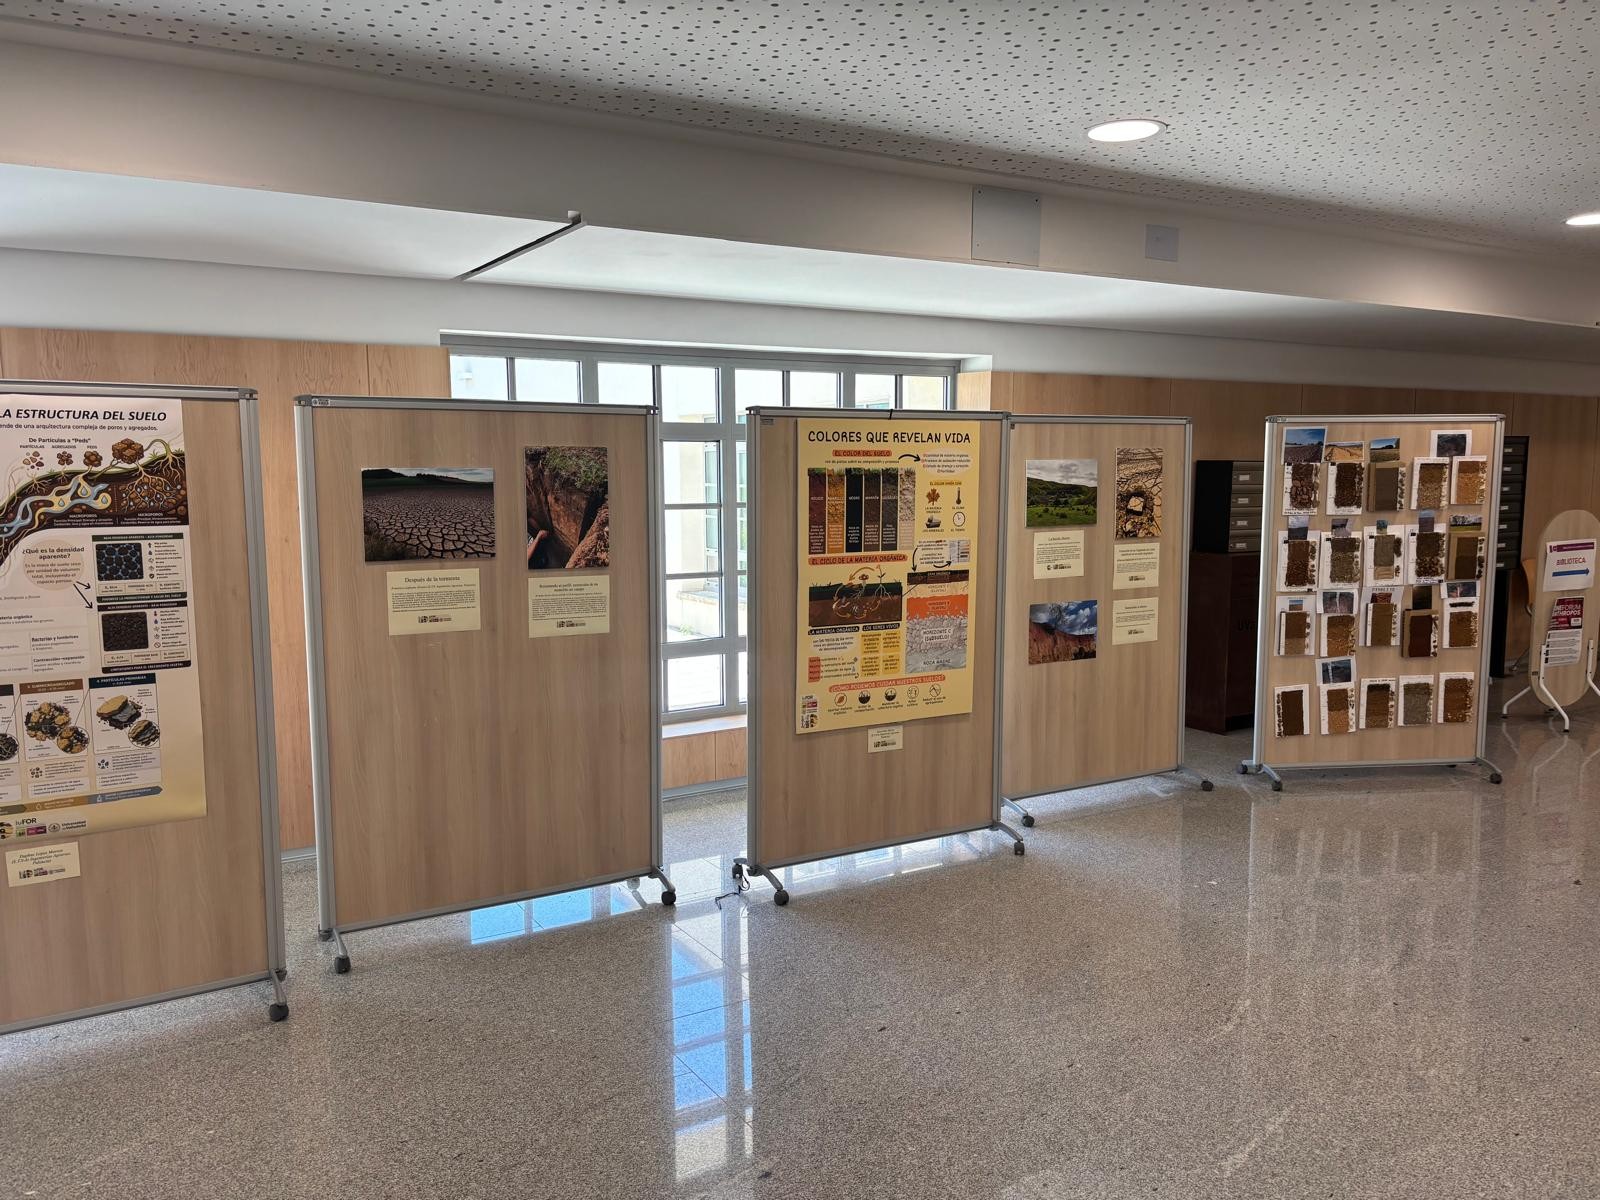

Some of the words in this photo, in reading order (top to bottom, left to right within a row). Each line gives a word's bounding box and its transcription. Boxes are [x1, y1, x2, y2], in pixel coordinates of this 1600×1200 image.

[0, 408, 12, 419] A
[16, 408, 99, 420] ESTRUCTURA
[102, 410, 125, 421] DEL
[128, 411, 167, 422] SUELO
[36, 423, 71, 431] arquitectura
[72, 424, 98, 432] compleja
[808, 430, 862, 443] COLORES
[866, 431, 889, 444] QUE
[892, 432, 941, 444] REVELAN
[944, 432, 971, 444] VIDA
[1556, 557, 1586, 566] BIBLIOTECA
